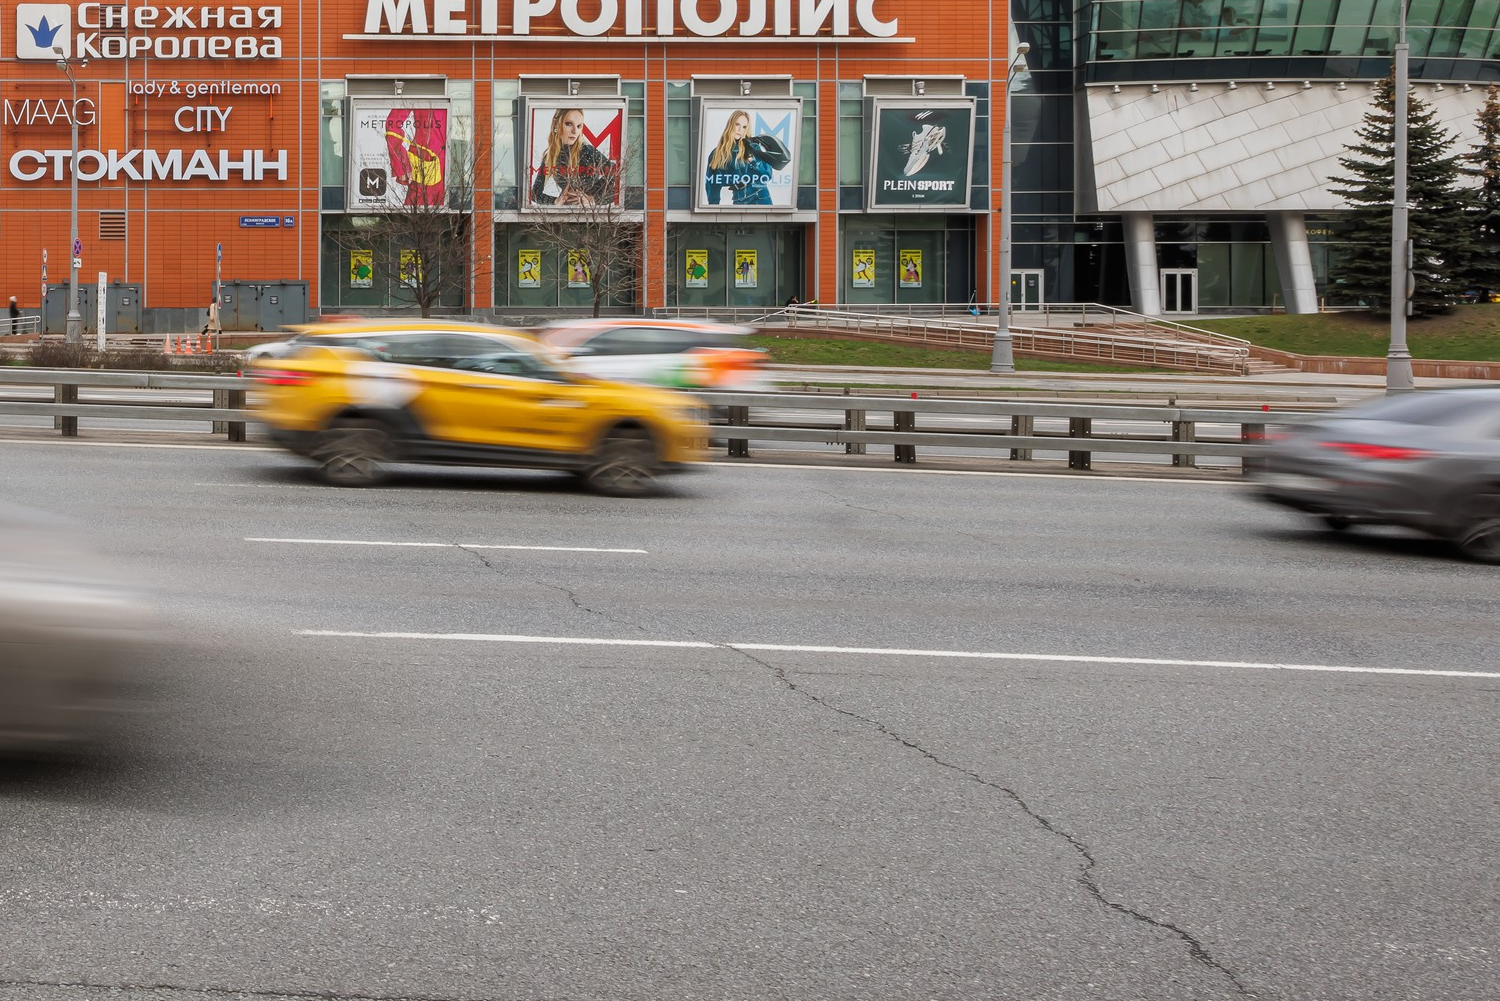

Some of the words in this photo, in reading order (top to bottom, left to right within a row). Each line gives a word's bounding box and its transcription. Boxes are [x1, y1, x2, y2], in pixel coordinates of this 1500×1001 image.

[77, 2, 282, 29] Снежная
[77, 32, 282, 59] Королева
[129, 80, 166, 98] lady
[169, 81, 181, 95] &
[185, 80, 281, 99] gentleman
[4, 98, 96, 125] MAAG
[174, 106, 233, 132] CITY
[360, 119, 442, 129] METROPOLIS
[9, 149, 288, 181] СТОКМАНН
[705, 173, 791, 185] METROPOLIS
[884, 180, 916, 191] PLEIN
[917, 180, 955, 191] SPORT
